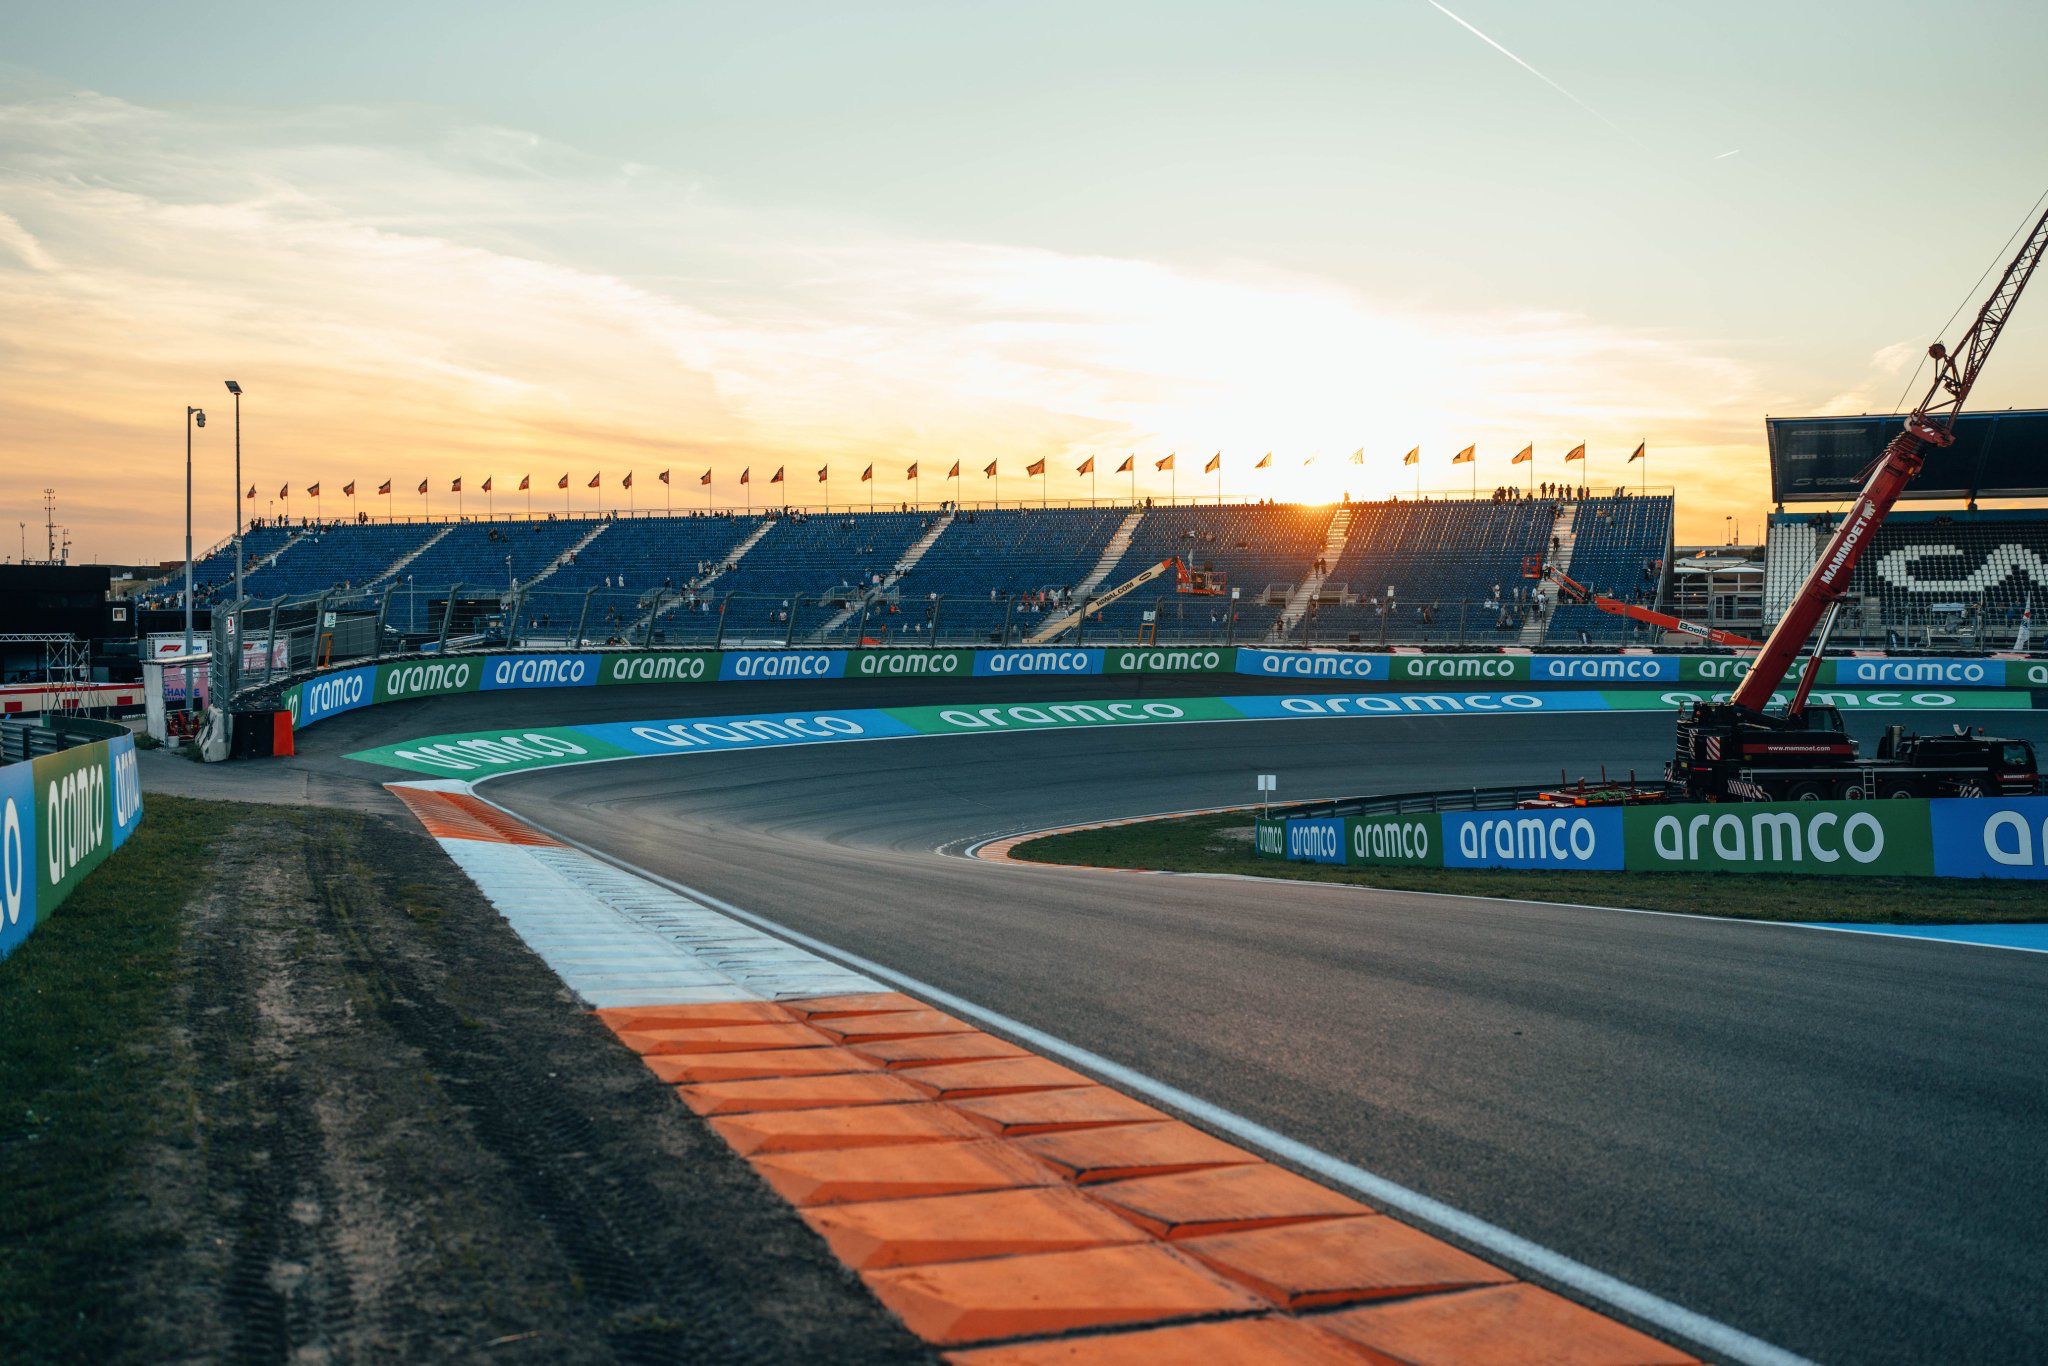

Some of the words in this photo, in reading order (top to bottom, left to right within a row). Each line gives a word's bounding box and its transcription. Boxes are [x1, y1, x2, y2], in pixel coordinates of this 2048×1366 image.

[1820, 516, 1868, 584] MAMMOET
[1096, 581, 1134, 606] RIWAL.COM
[1680, 622, 1708, 636] Boels
[495, 659, 585, 684] aramco
[612, 657, 705, 680] aramco
[735, 655, 830, 676] aramco
[860, 654, 958, 674] aramco
[990, 652, 1088, 672] aramco
[1120, 651, 1220, 671] aramco
[1262, 654, 1373, 676] aramco
[1407, 659, 1515, 677] aramco
[1548, 659, 1661, 678] aramco
[1698, 660, 1808, 680] arac
[1857, 663, 1985, 682] aramco
[387, 663, 470, 695] aramco
[310, 674, 363, 716] aramco
[1280, 693, 1543, 715] aramco
[939, 702, 1185, 729] aramco
[630, 716, 865, 747] aramco
[394, 733, 588, 770] aramco
[48, 764, 104, 885] aramco
[1292, 825, 1337, 858] aramco
[1353, 822, 1428, 859] aramco
[1459, 817, 1596, 861] aramco
[1653, 811, 1885, 864] aramco
[0, 797, 22, 926] o
